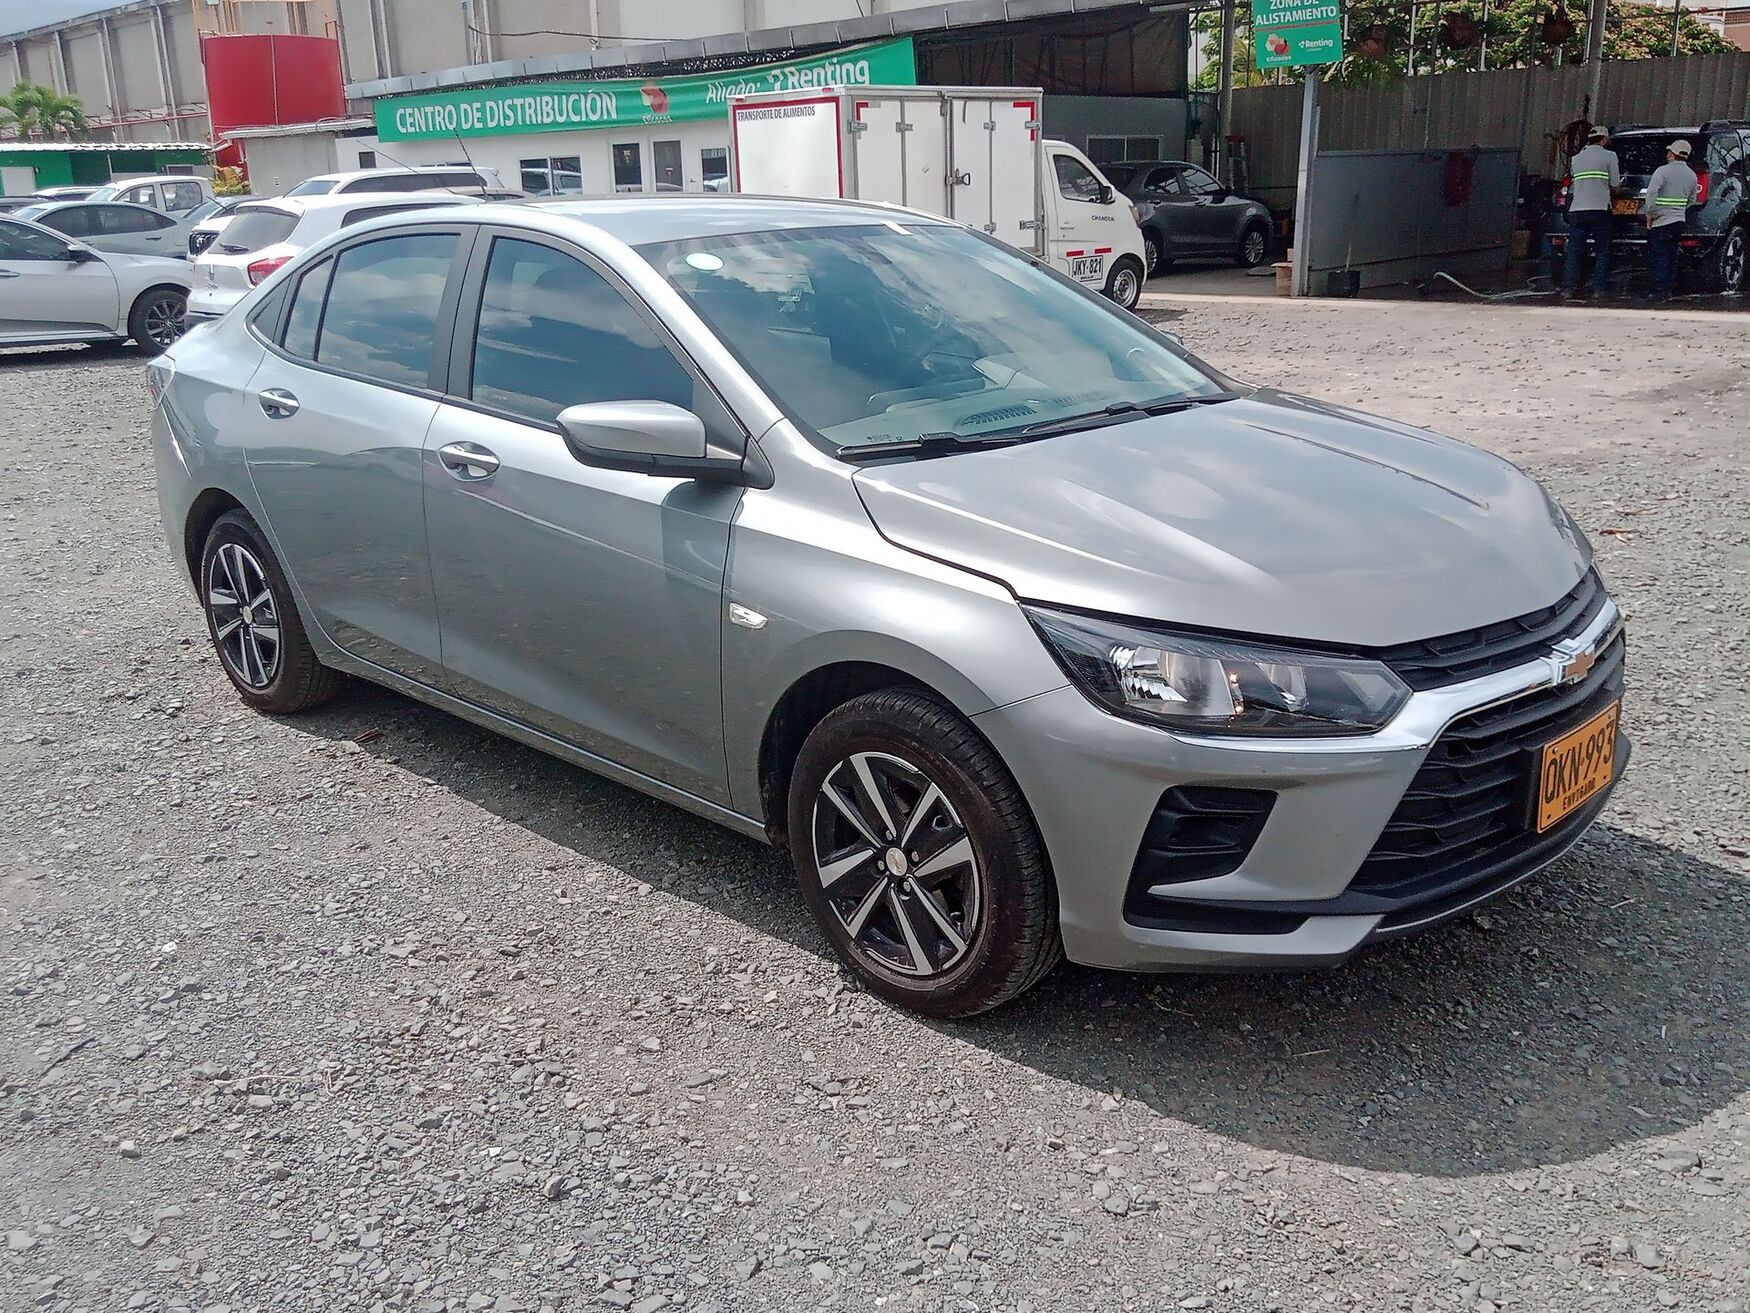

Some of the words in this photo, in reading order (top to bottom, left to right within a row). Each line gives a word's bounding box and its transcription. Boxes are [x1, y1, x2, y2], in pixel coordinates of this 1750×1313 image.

[1270, 0, 1301, 9] ZONA
[1256, 6, 1336, 25] ALISTAMIENTO
[1305, 38, 1333, 48] Renting
[786, 57, 870, 90] Renting
[396, 103, 458, 133] CENTRO
[460, 100, 483, 130] DE
[486, 88, 618, 126] DISTRIBUCIÓN
[737, 108, 774, 122] TRANSPORTE
[774, 108, 782, 119] DE
[782, 105, 816, 119] ALIMENTOS
